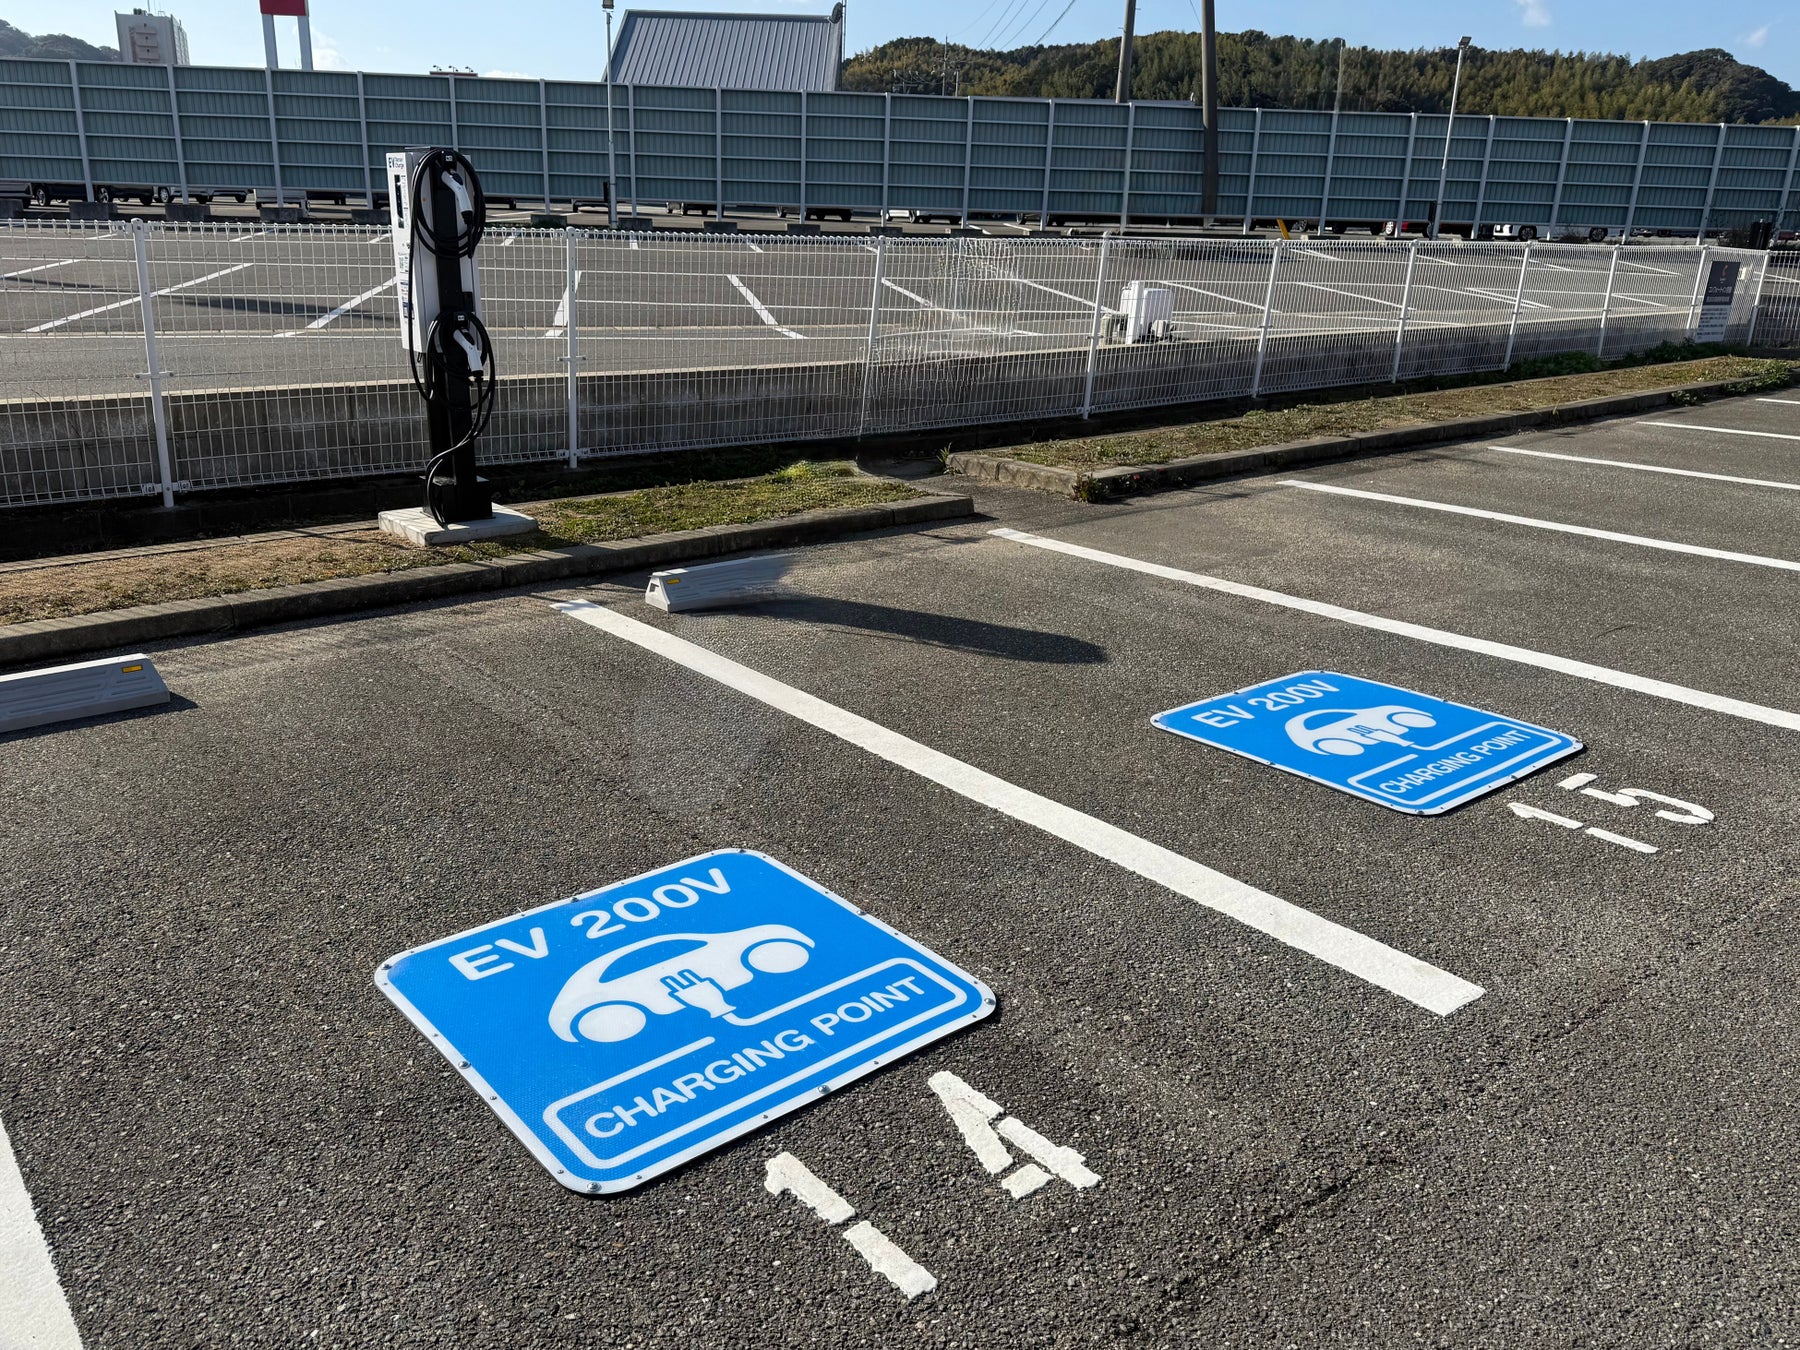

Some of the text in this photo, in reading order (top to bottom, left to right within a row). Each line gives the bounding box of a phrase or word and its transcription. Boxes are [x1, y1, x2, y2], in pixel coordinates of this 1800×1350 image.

[1191, 680, 1340, 728] EV 200V
[1379, 730, 1531, 793] CHARGING POINT
[1506, 772, 1715, 854] 15
[448, 868, 731, 981] EV 200V
[585, 976, 925, 1138] CHARGING POINT
[764, 1070, 1102, 1304] 14
